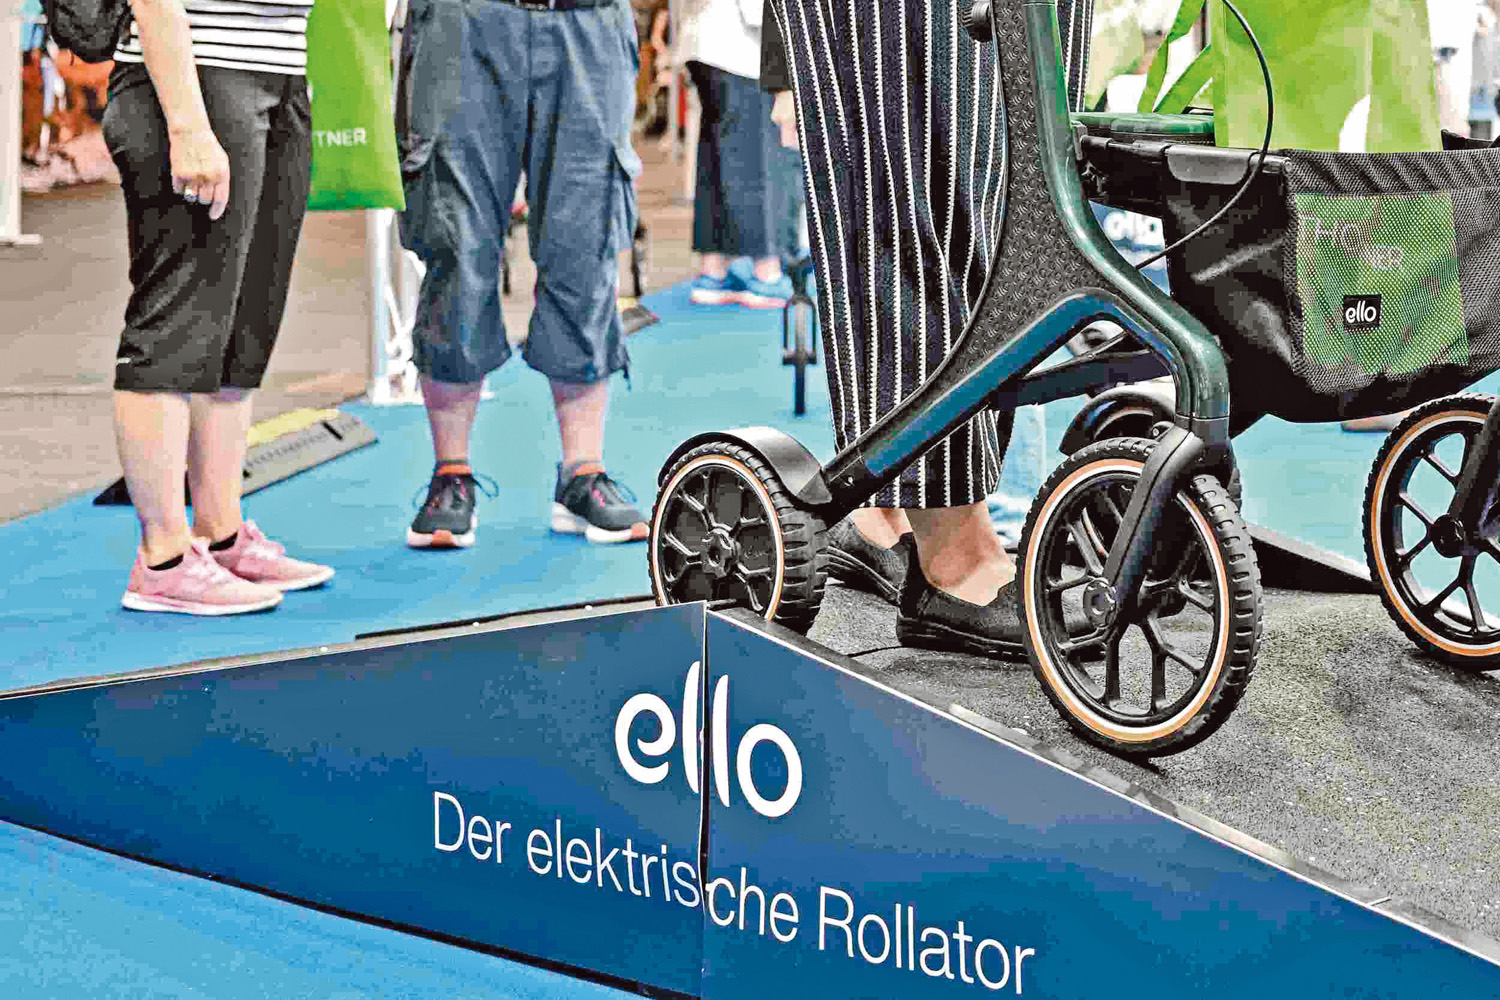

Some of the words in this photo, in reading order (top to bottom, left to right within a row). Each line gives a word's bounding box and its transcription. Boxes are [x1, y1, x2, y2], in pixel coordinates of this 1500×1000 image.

[312, 125, 367, 148] TNER
[1345, 300, 1377, 323] ello
[614, 660, 803, 818] ello
[433, 790, 511, 864] Der
[526, 819, 799, 942] elektrische
[818, 886, 1036, 994] Rollator
